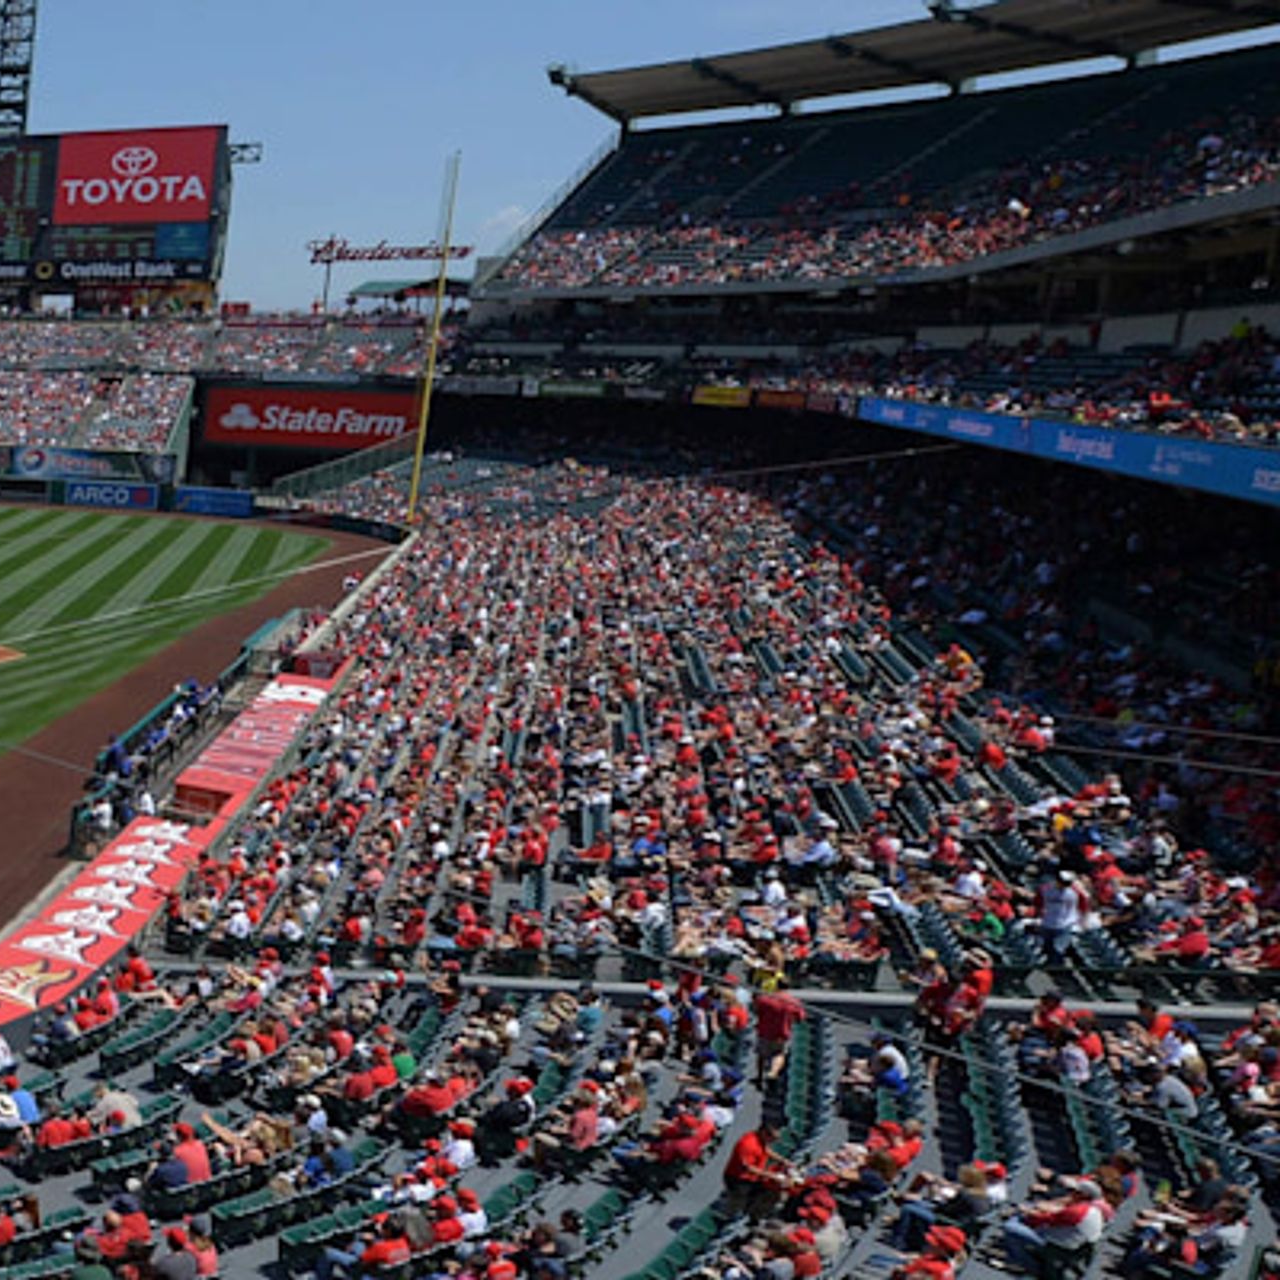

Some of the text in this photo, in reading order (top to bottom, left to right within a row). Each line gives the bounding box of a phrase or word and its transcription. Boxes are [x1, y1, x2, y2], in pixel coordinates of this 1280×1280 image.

[62, 174, 207, 205] TOYOTA
[60, 260, 176, 279] OneWest Bank
[72, 485, 130, 505] ARCO
